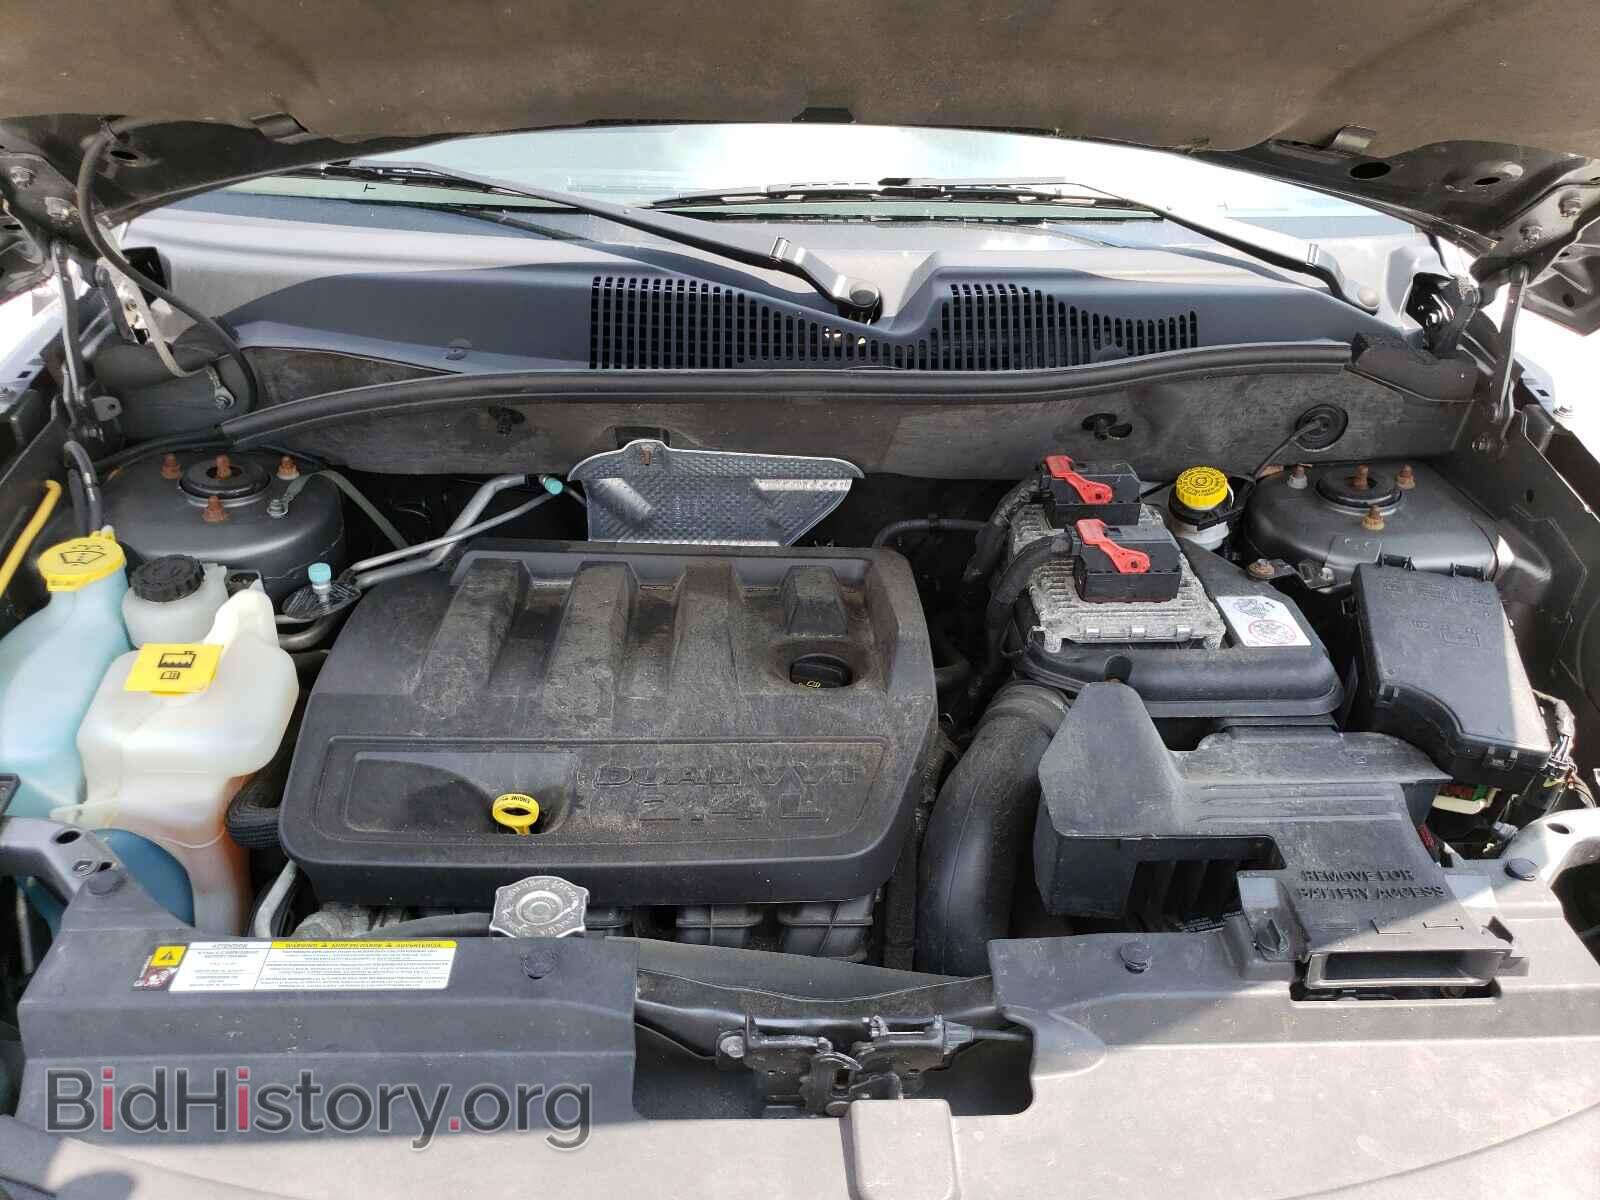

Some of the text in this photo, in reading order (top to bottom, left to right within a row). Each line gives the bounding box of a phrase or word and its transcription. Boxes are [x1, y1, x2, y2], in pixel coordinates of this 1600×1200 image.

[1301, 869, 1415, 882] REMOVE FOR
[1297, 886, 1445, 900] BATTERY ACCESS
